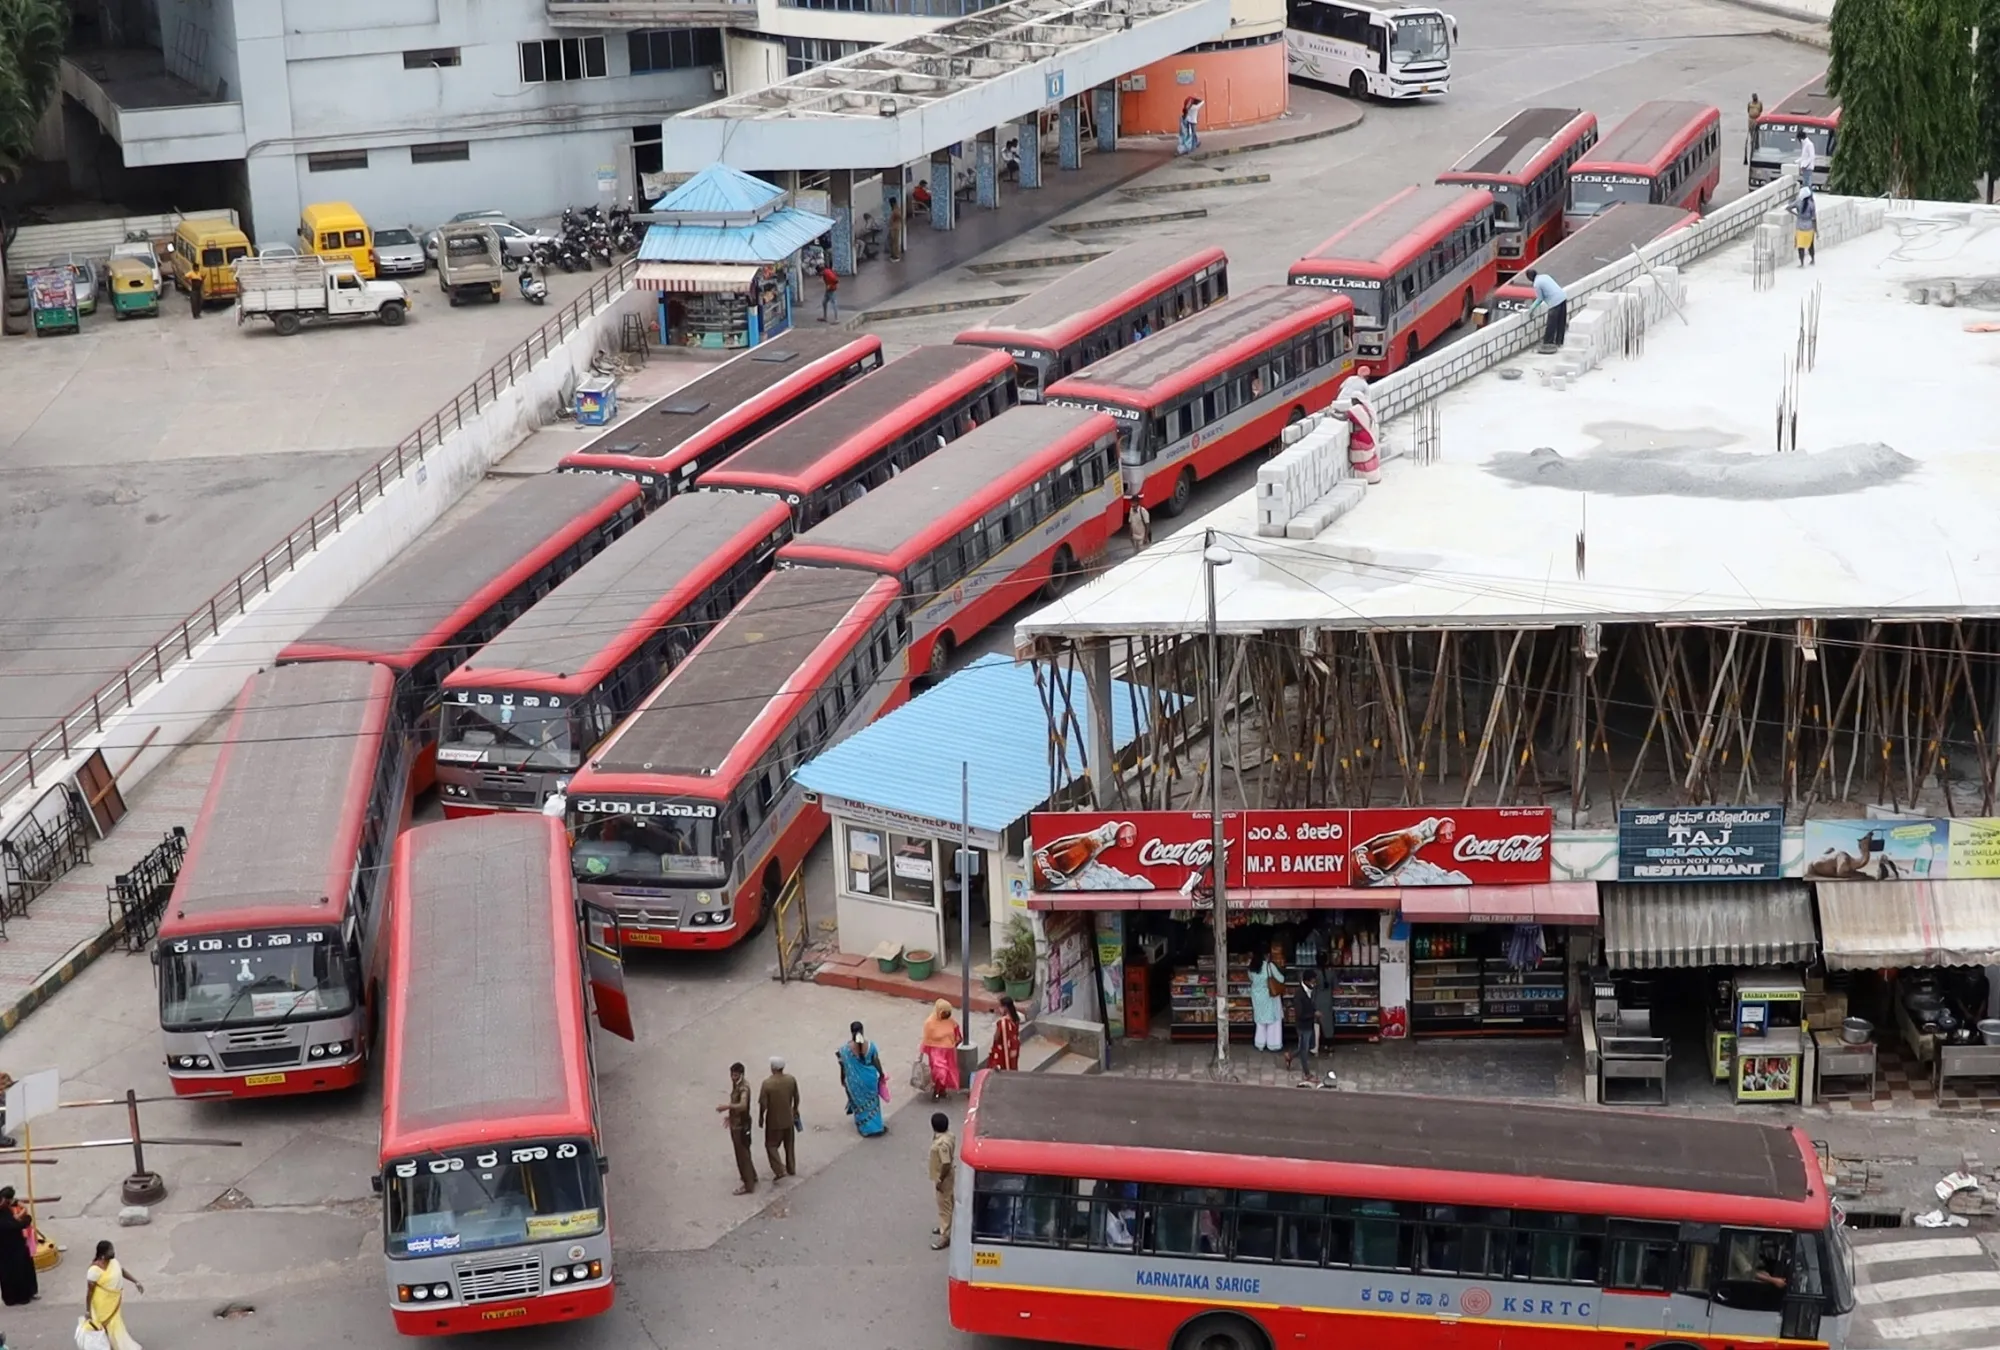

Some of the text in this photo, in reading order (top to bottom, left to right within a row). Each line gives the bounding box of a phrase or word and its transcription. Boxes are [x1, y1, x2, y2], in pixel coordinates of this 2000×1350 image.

[1296, 822, 1343, 840] ಬೇಕರಿ
[1668, 826, 1732, 846] TAJ
[1453, 833, 1550, 862] Coca-Cola
[1646, 847, 1754, 857] BHAVAN
[1247, 855, 1276, 873] M.P.
[1634, 864, 1765, 877] RESTAURANT
[1136, 1269, 1260, 1294] KARNATAKA SARIGE
